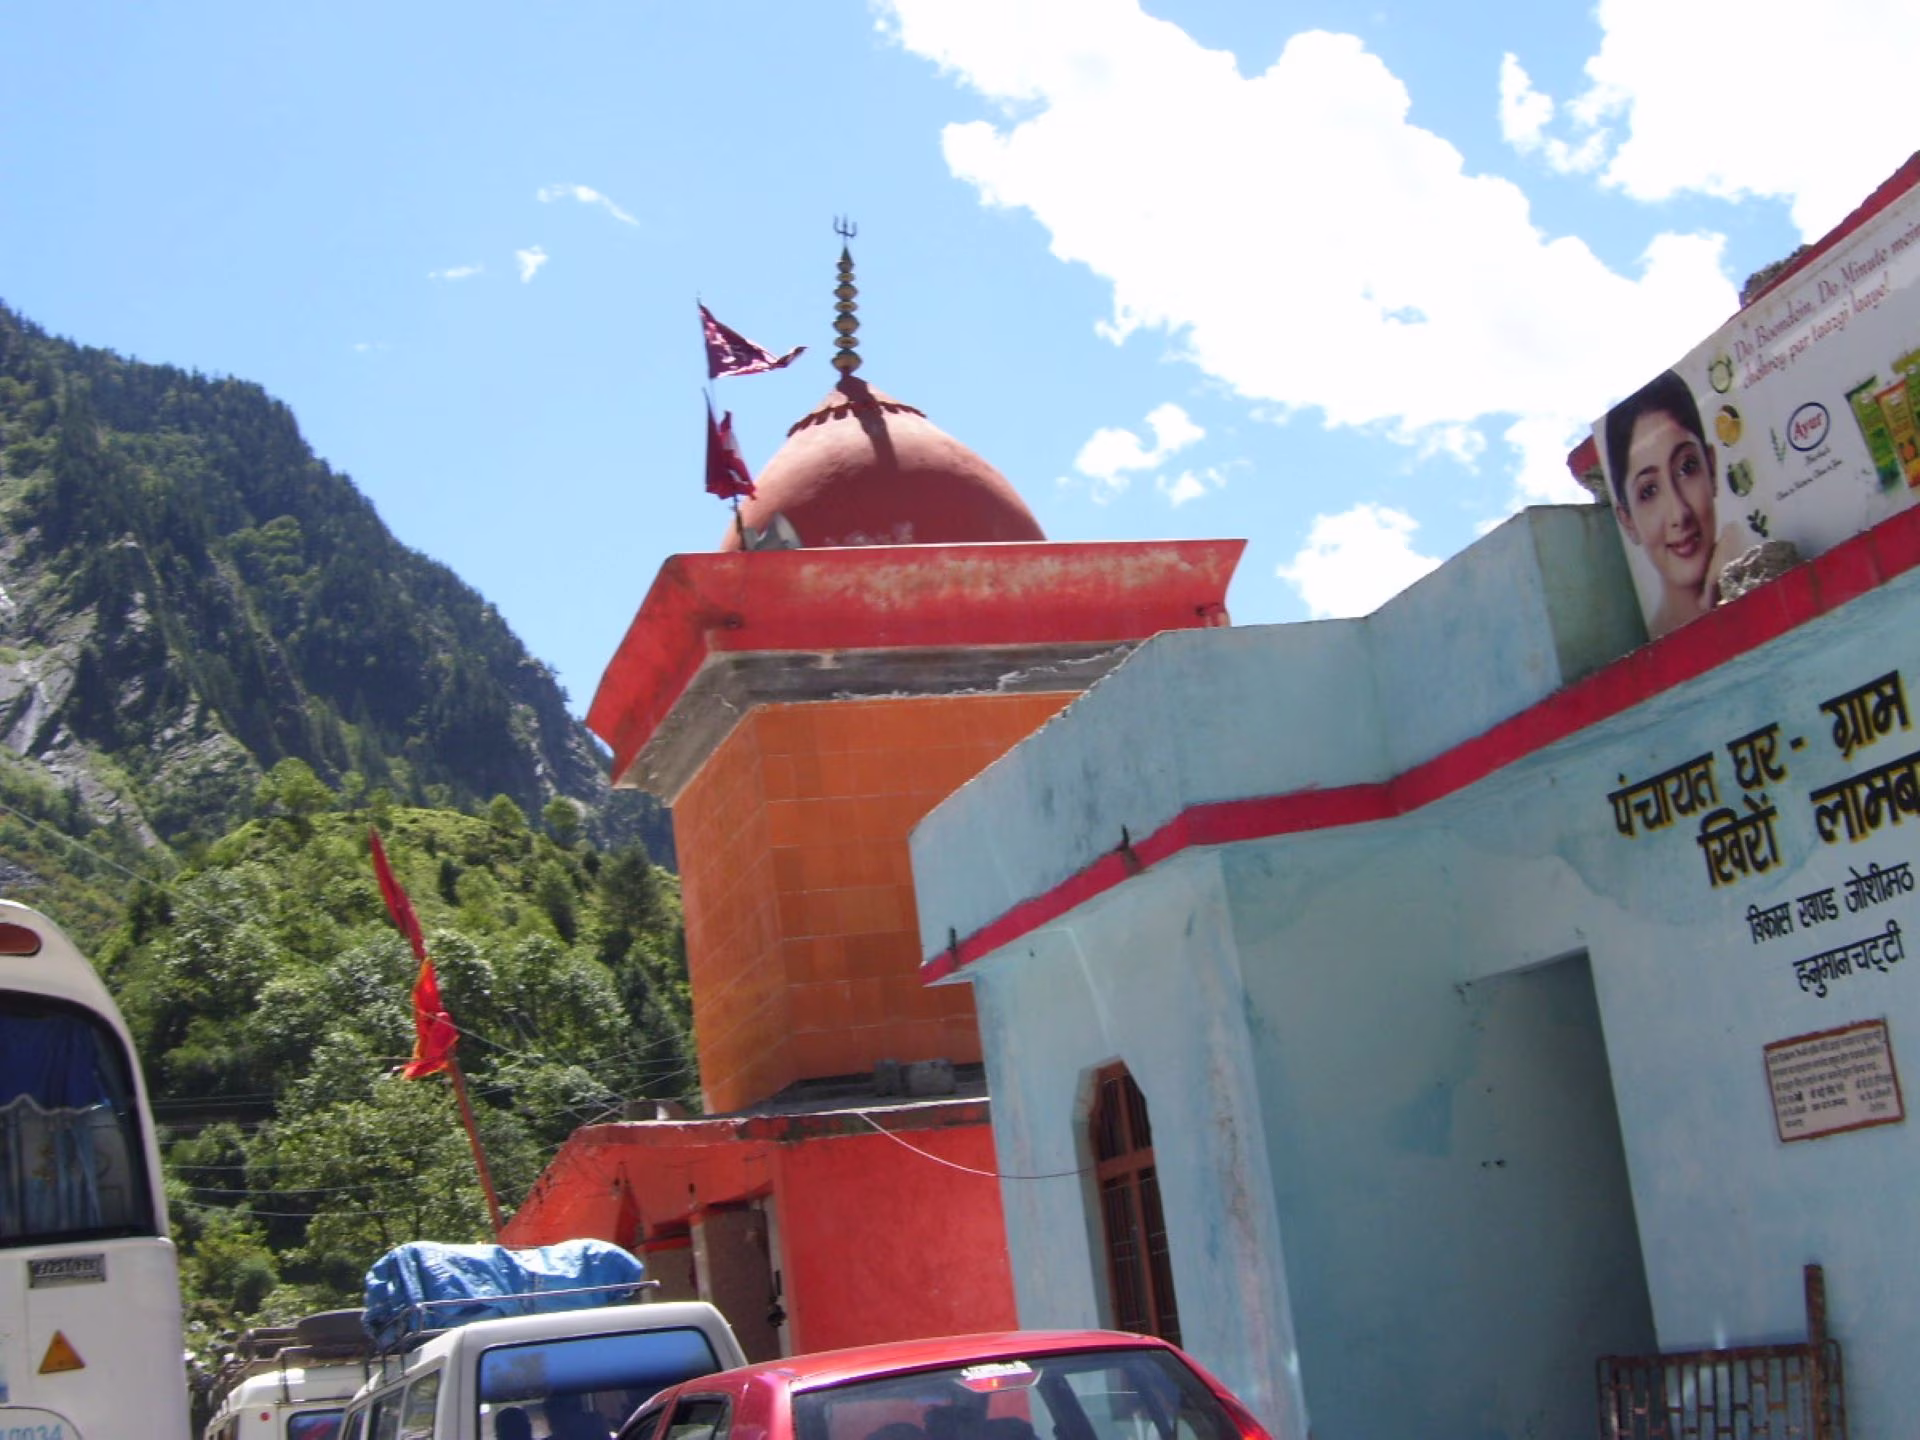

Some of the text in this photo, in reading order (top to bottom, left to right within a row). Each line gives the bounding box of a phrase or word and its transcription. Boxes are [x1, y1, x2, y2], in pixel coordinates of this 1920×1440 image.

[1794, 413, 1824, 441] Ayur
[1607, 751, 1720, 838] पंचायत
[1725, 722, 1786, 789] घर
[1818, 669, 1911, 761] ग्राम
[1796, 887, 1840, 928] खण्ड
[1844, 861, 1914, 913] जोशीमठ
